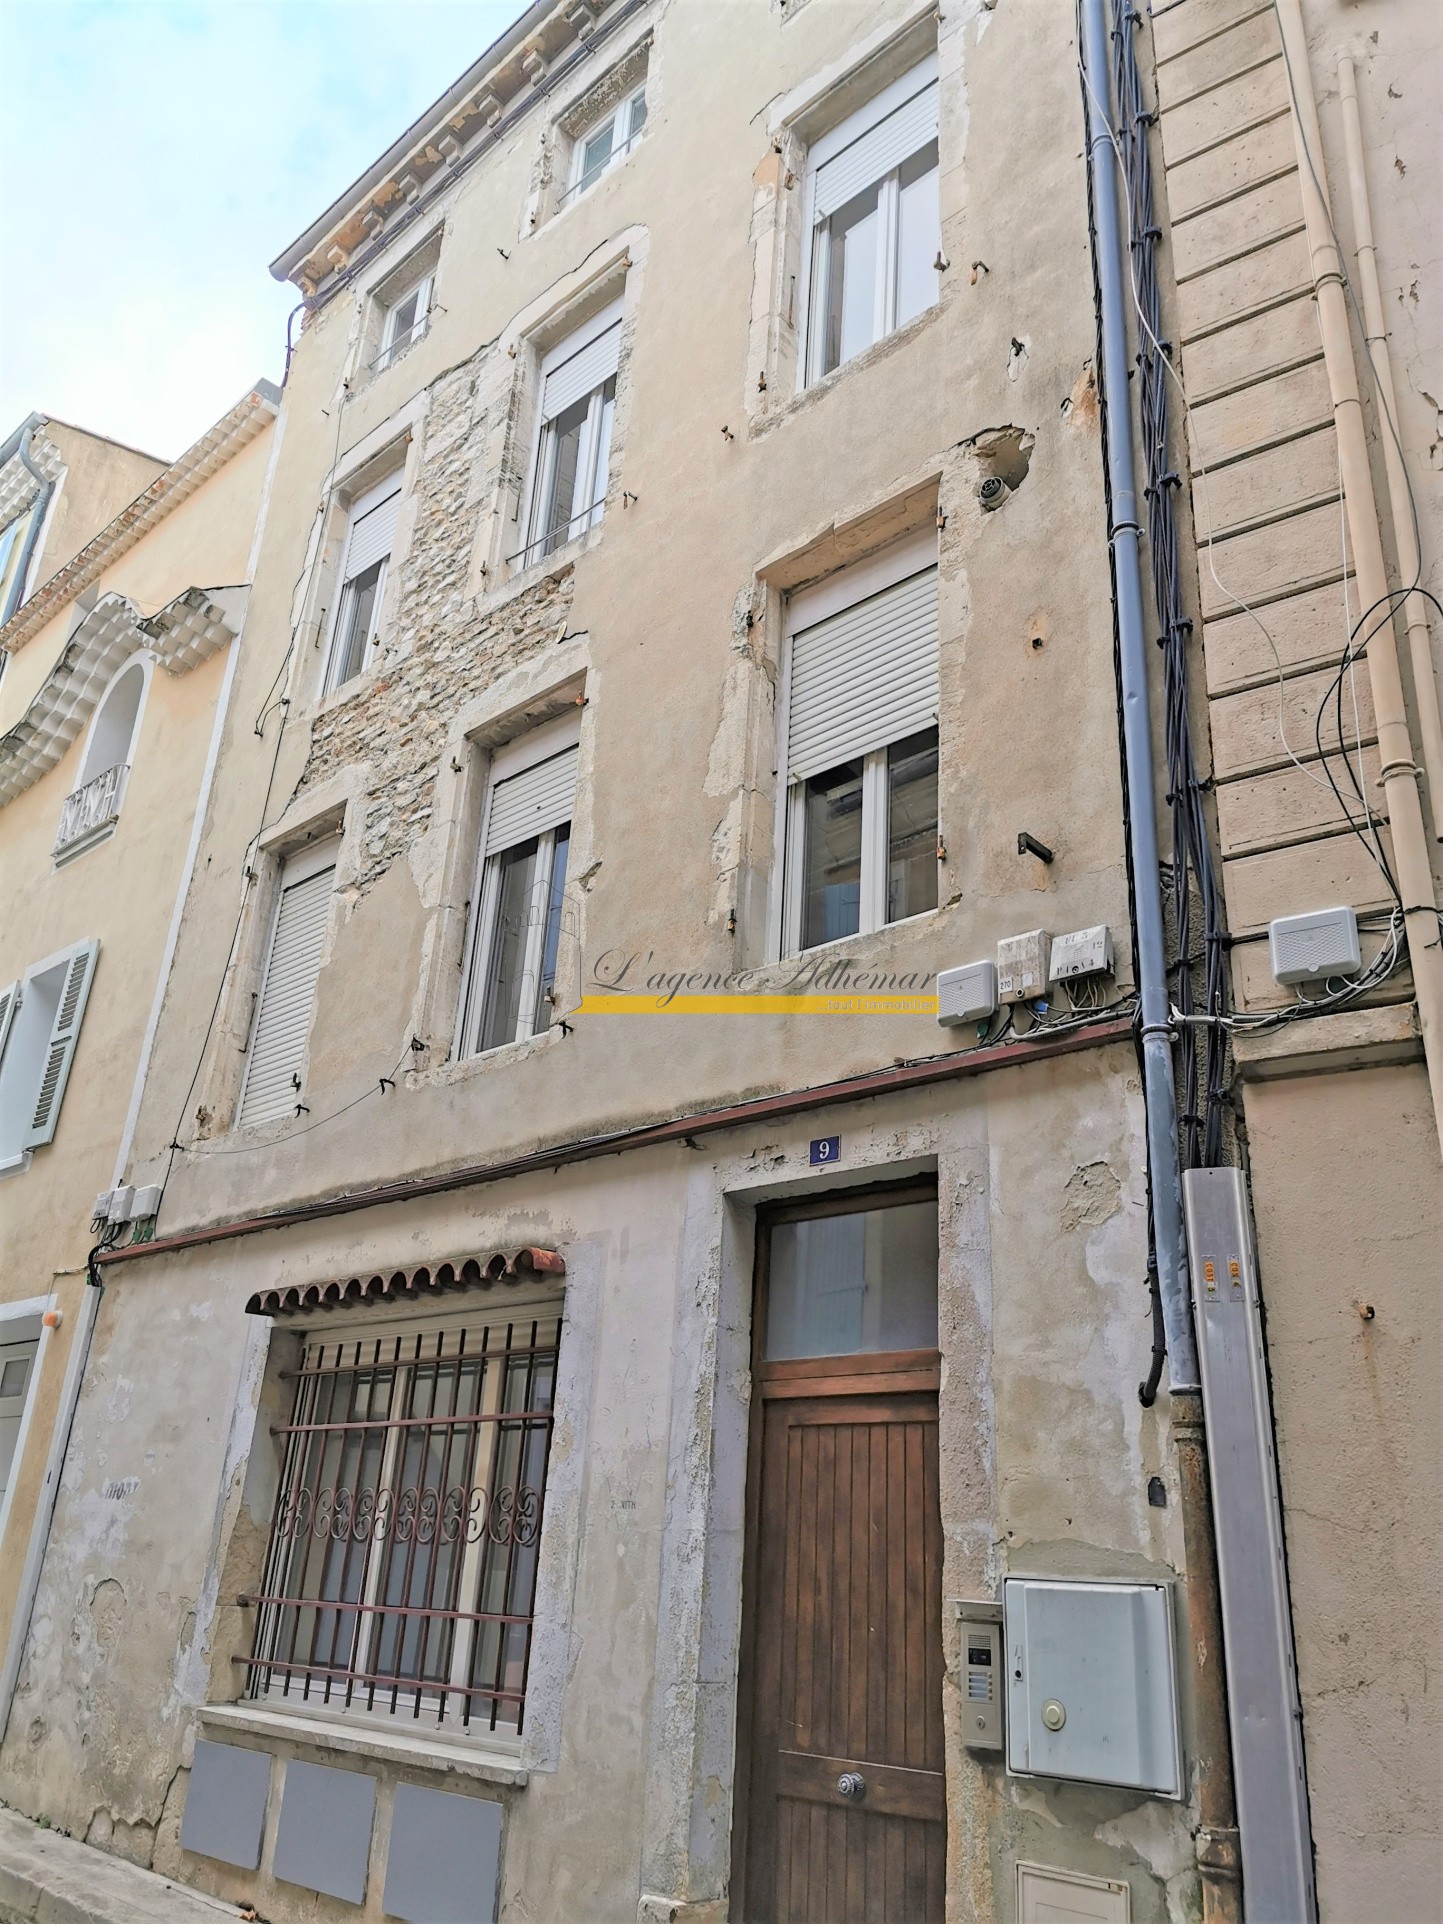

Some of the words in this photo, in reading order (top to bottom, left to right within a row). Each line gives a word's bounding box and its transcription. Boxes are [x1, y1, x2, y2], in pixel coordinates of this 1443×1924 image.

[1000, 981, 1011, 990] 270
[819, 1141, 830, 1159] 9
[610, 1500, 637, 1510] ZNITH
